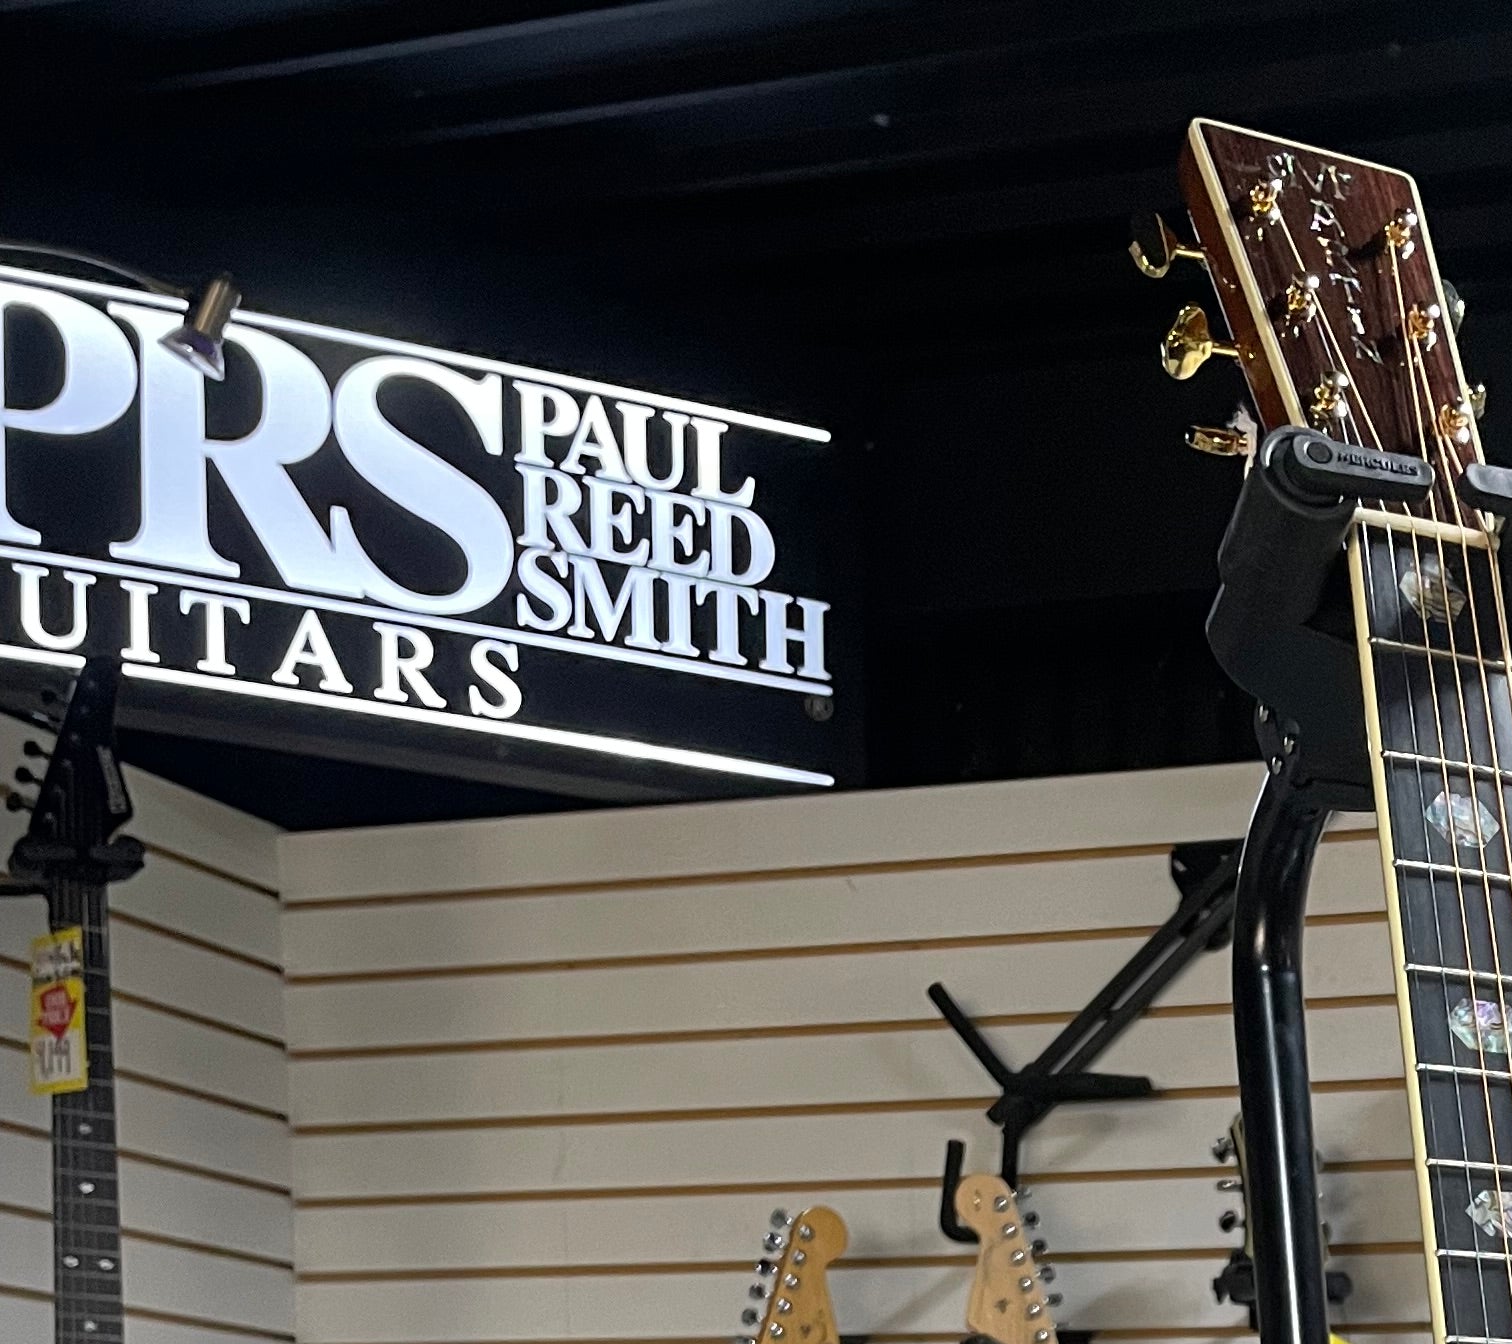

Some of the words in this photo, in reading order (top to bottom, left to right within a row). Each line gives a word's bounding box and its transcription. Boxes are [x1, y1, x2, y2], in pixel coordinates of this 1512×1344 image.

[0, 280, 514, 617] PRS
[512, 378, 756, 509] PAUL
[1337, 451, 1418, 477] HERCULES
[515, 461, 776, 588] REED
[516, 544, 832, 682] SMITH
